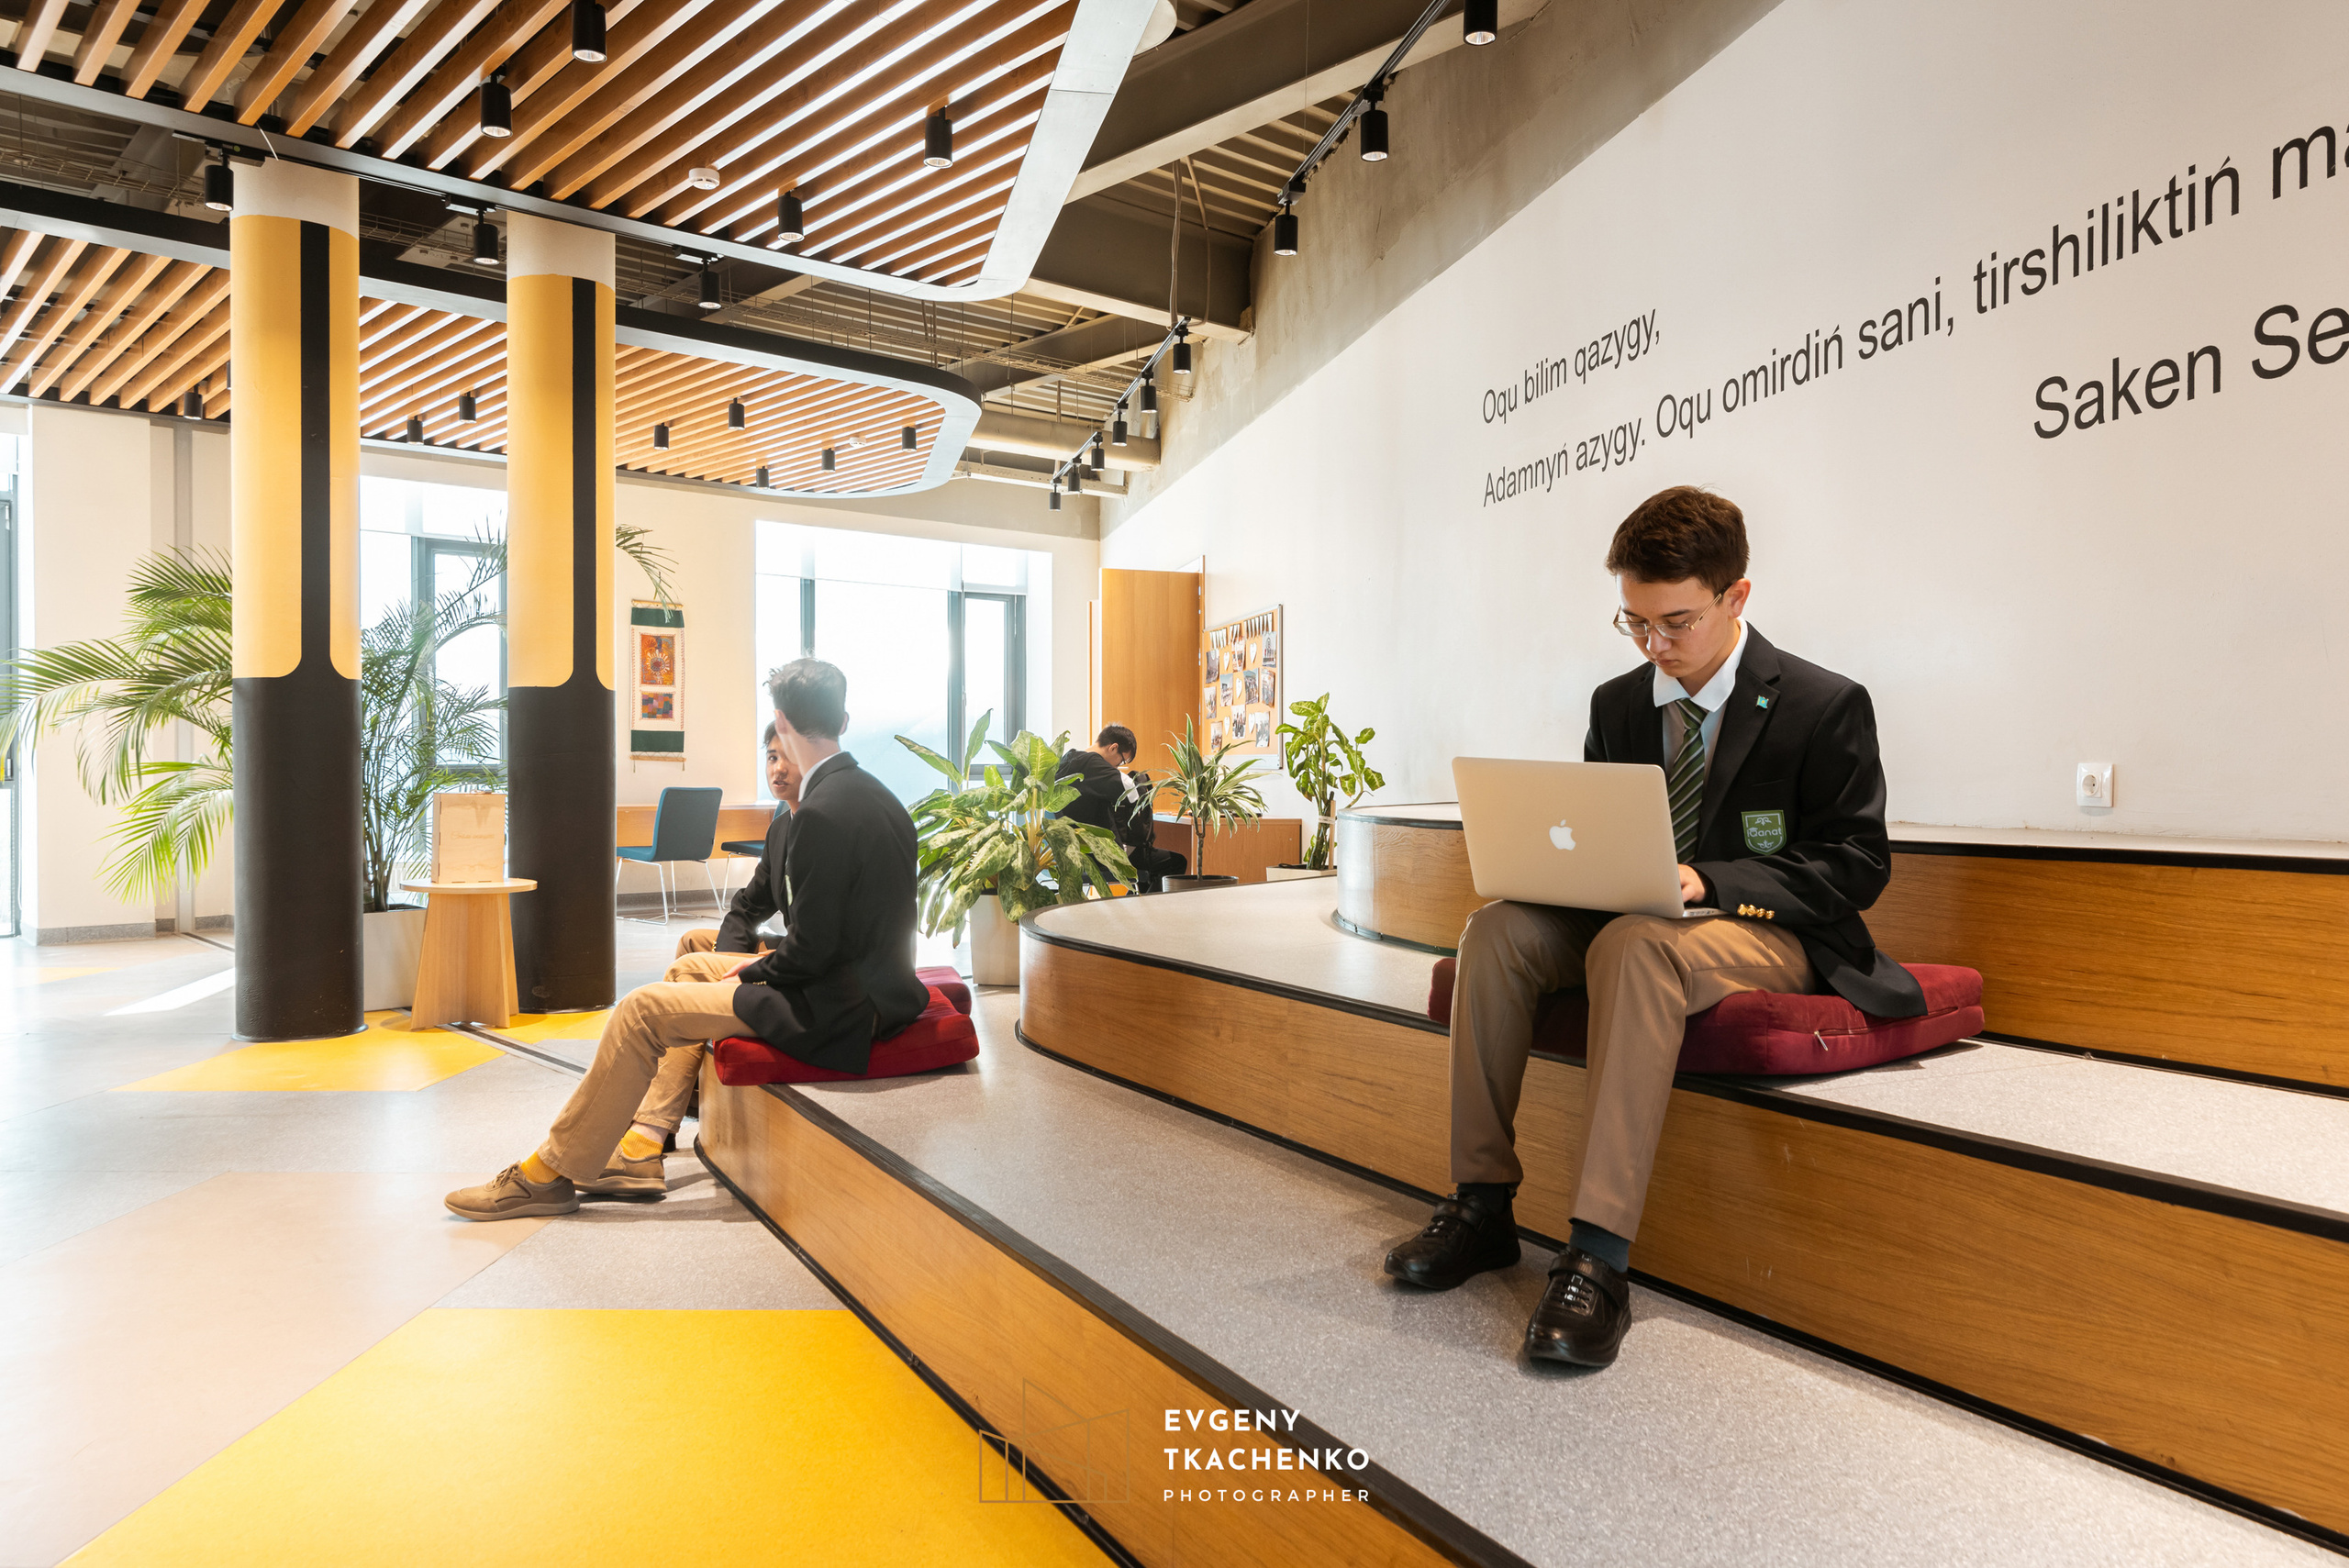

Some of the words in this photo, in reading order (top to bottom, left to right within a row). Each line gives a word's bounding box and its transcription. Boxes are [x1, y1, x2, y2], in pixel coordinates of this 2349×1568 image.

[1575, 417, 1646, 473] azygy.
[1655, 388, 1712, 439] Oqu
[1856, 275, 1955, 361] sani,
[2272, 123, 2349, 201] m
[1483, 384, 1518, 425] Oqu
[1524, 357, 1567, 405] bilim
[1574, 308, 1661, 384] qazygy,
[2033, 344, 2221, 439] Saken
